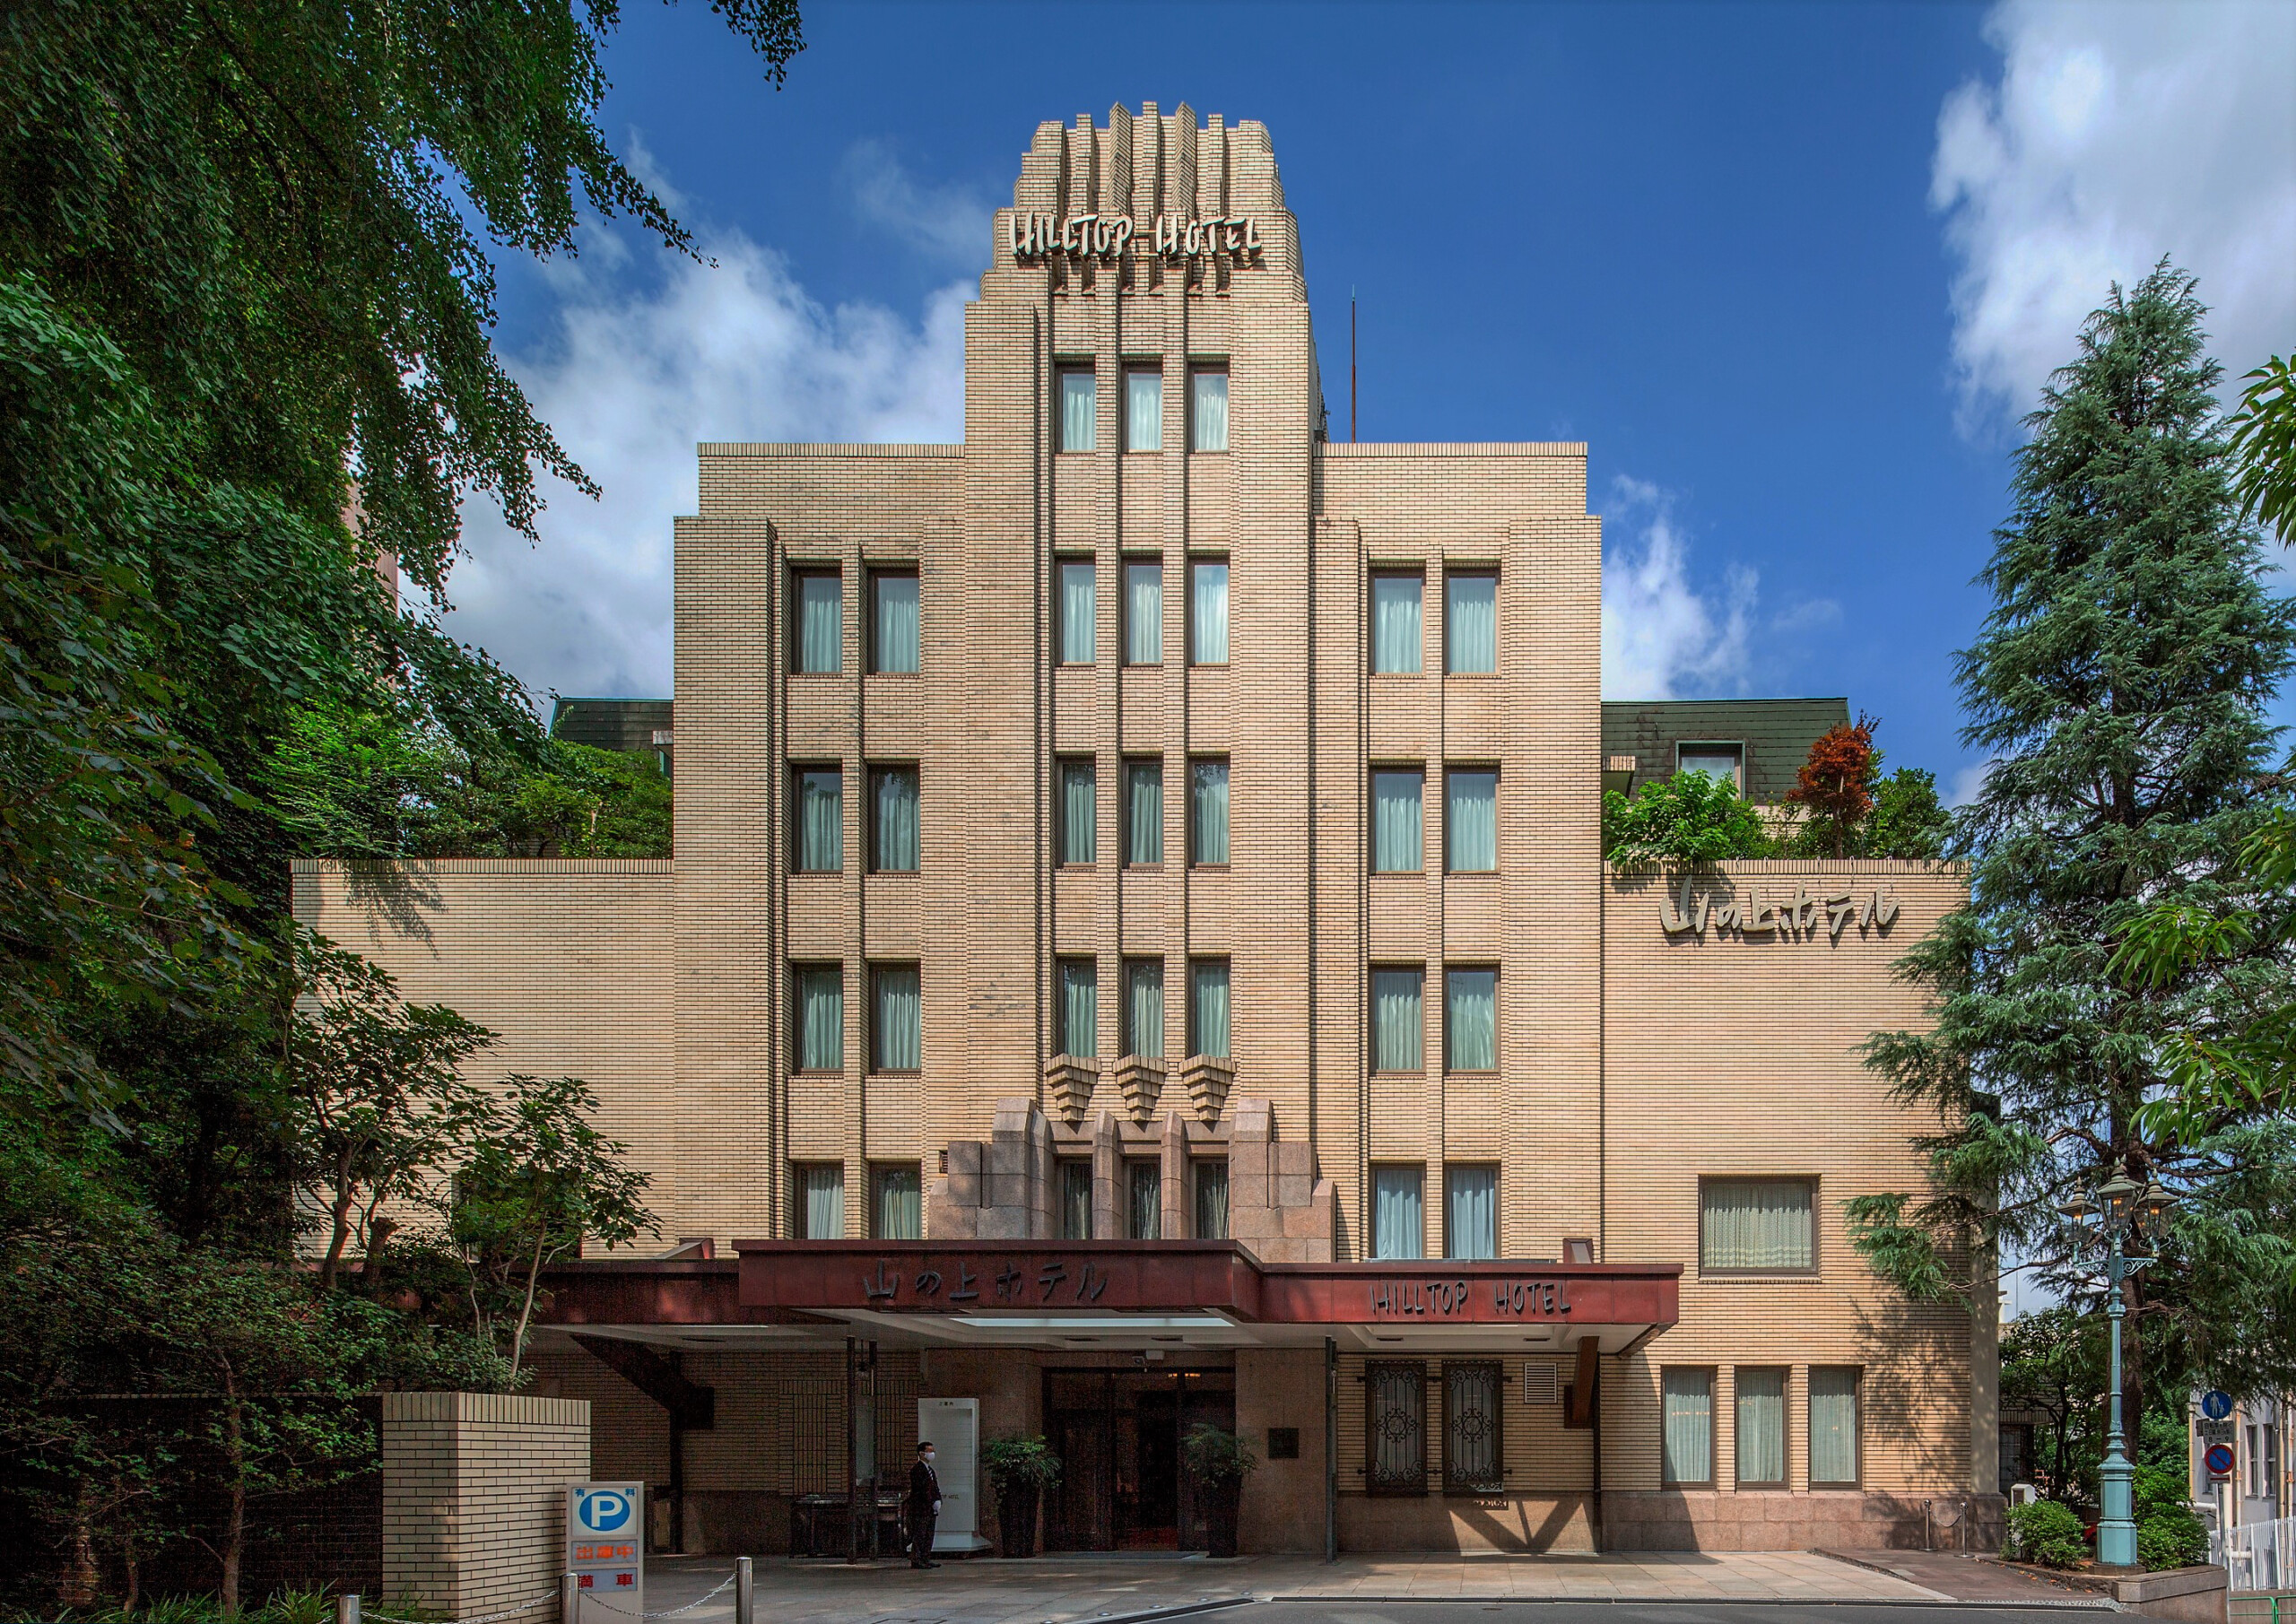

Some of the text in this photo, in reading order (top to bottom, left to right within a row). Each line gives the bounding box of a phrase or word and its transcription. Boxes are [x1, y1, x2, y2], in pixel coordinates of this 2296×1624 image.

[1008, 211, 1264, 257] HILLTOP HOTEL
[1659, 874, 1900, 936] 山の上ホテル
[863, 1259, 1109, 1300] 山の上ホテル
[1369, 1280, 1571, 1316] HILLTOP HOTEL
[591, 1496, 623, 1528] P
[576, 1545, 634, 1560] 出庫中
